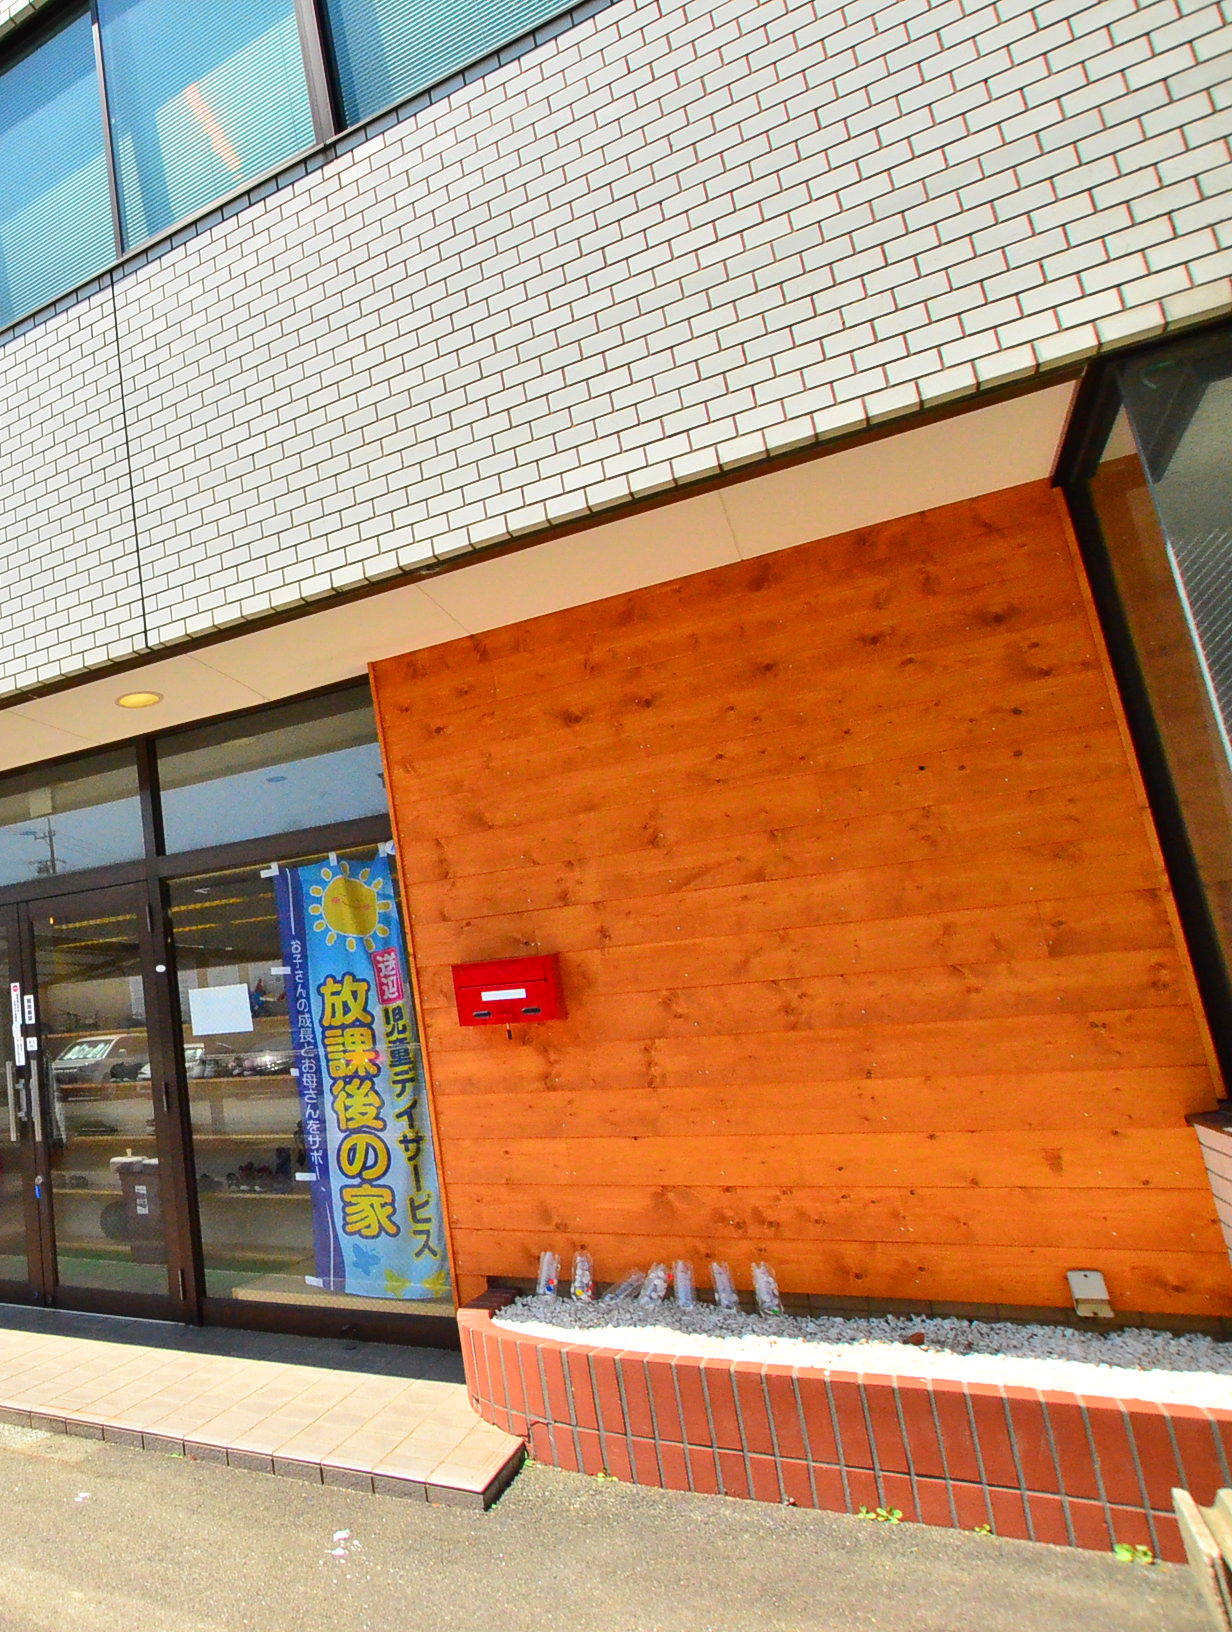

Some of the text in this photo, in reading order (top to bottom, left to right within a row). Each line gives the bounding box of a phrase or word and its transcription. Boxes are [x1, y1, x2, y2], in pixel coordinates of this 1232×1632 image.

[290, 940, 326, 1193] お子さんの成長とお母さんをサポー
[376, 951, 399, 1000] 送迎
[319, 971, 399, 1239] 放課後の家
[384, 1005, 439, 1259] 児童デイサービス
